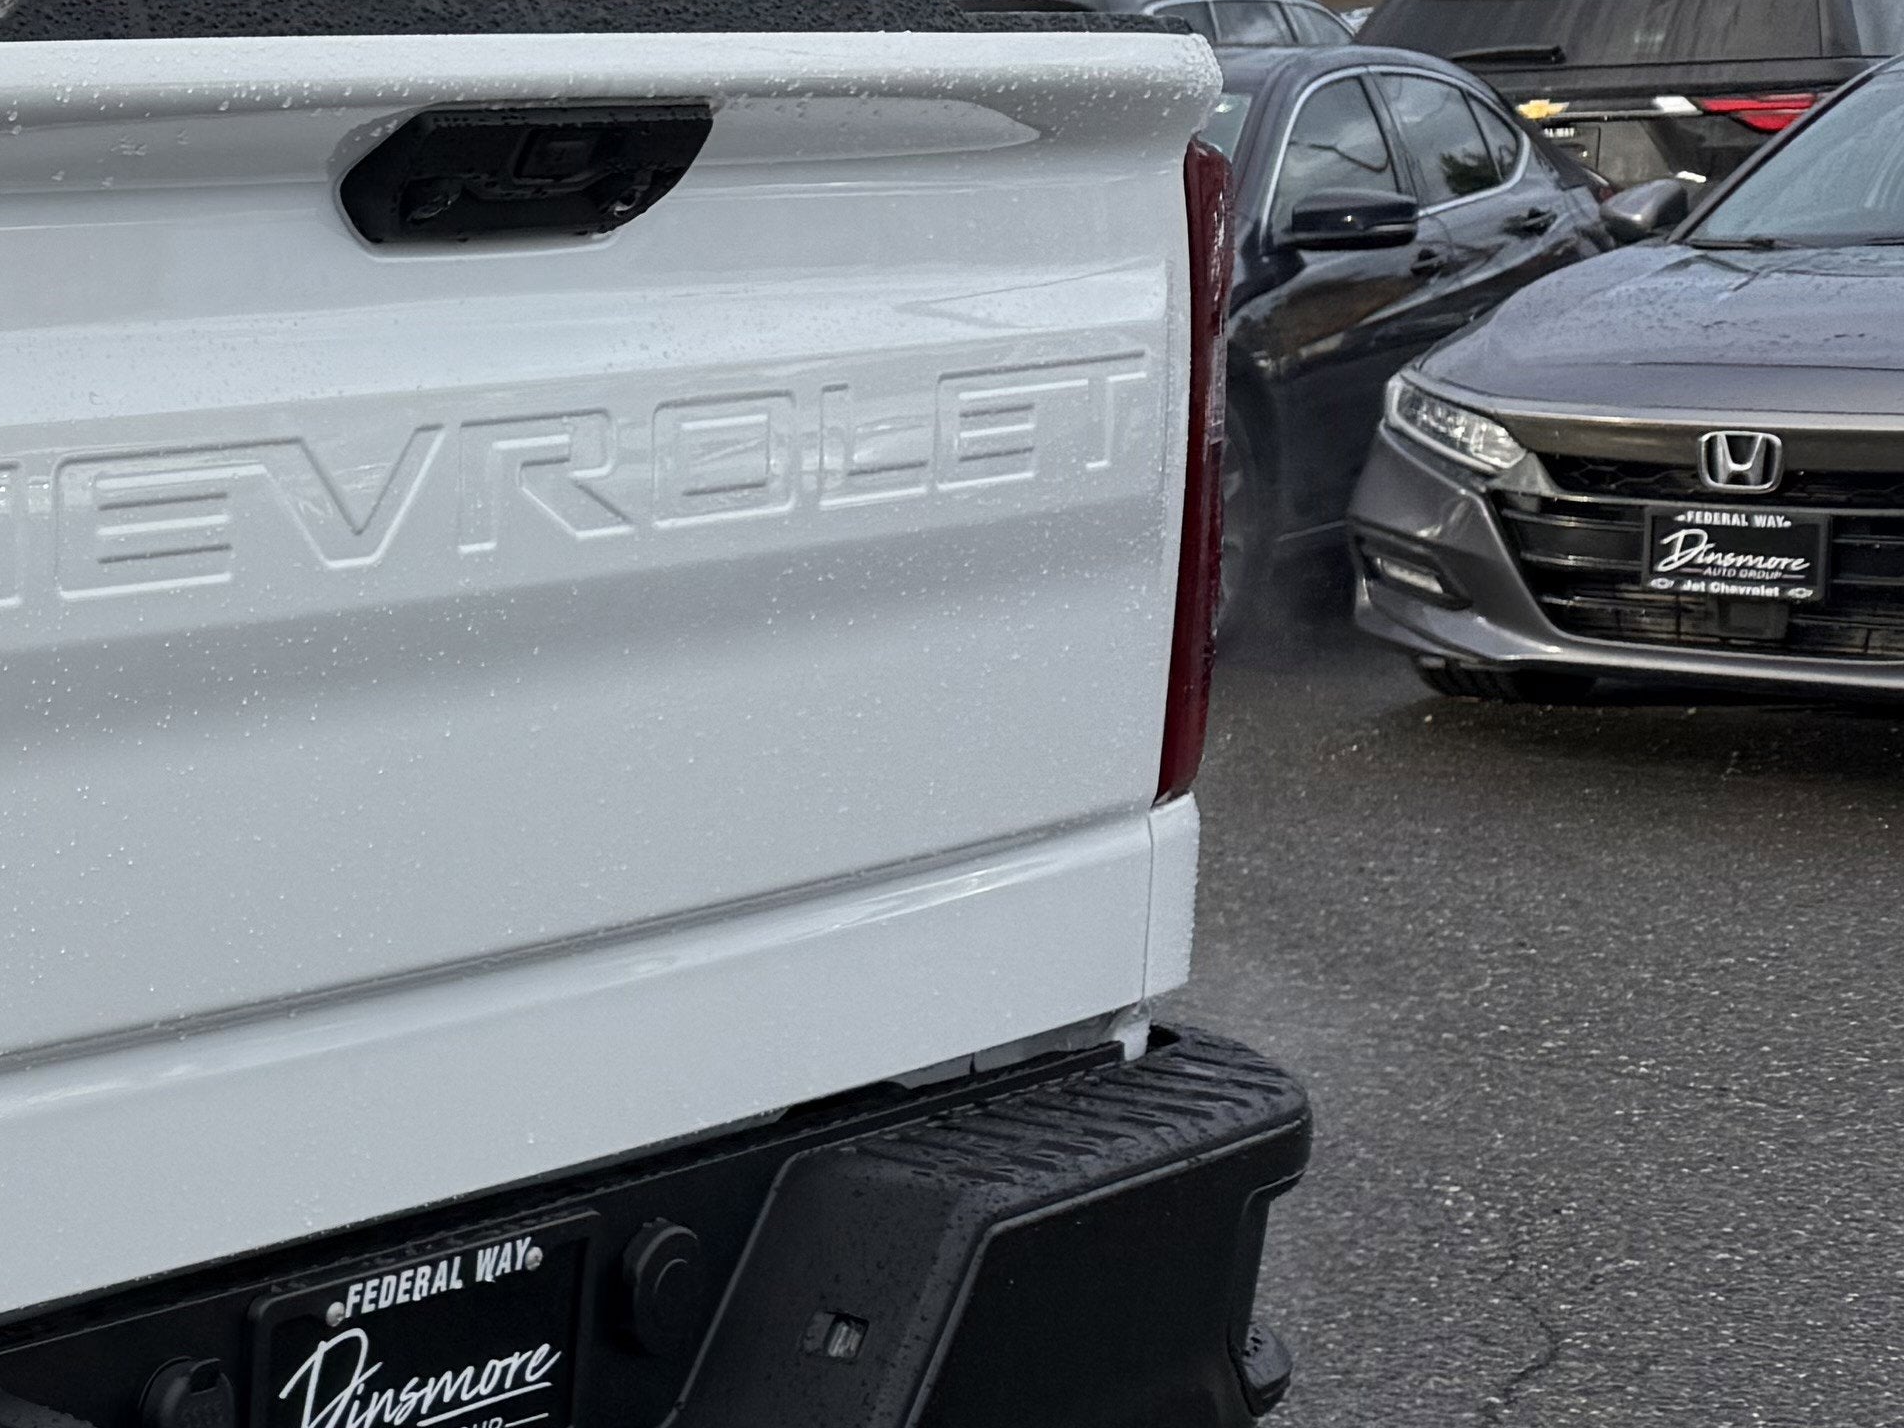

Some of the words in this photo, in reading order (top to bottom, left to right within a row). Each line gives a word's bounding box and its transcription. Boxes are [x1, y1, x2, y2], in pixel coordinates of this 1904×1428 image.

[1686, 510, 1749, 526] FEDERAL
[1753, 514, 1785, 528] WAY
[1656, 528, 1810, 572] Dinsmore
[1702, 566, 1736, 579] AUTO
[1738, 568, 1782, 580] GROUP
[1680, 579, 1706, 592] Jet
[1709, 581, 1780, 597] Chevrolet
[345, 1255, 463, 1319] FEDERAL
[476, 1236, 532, 1283] WAY
